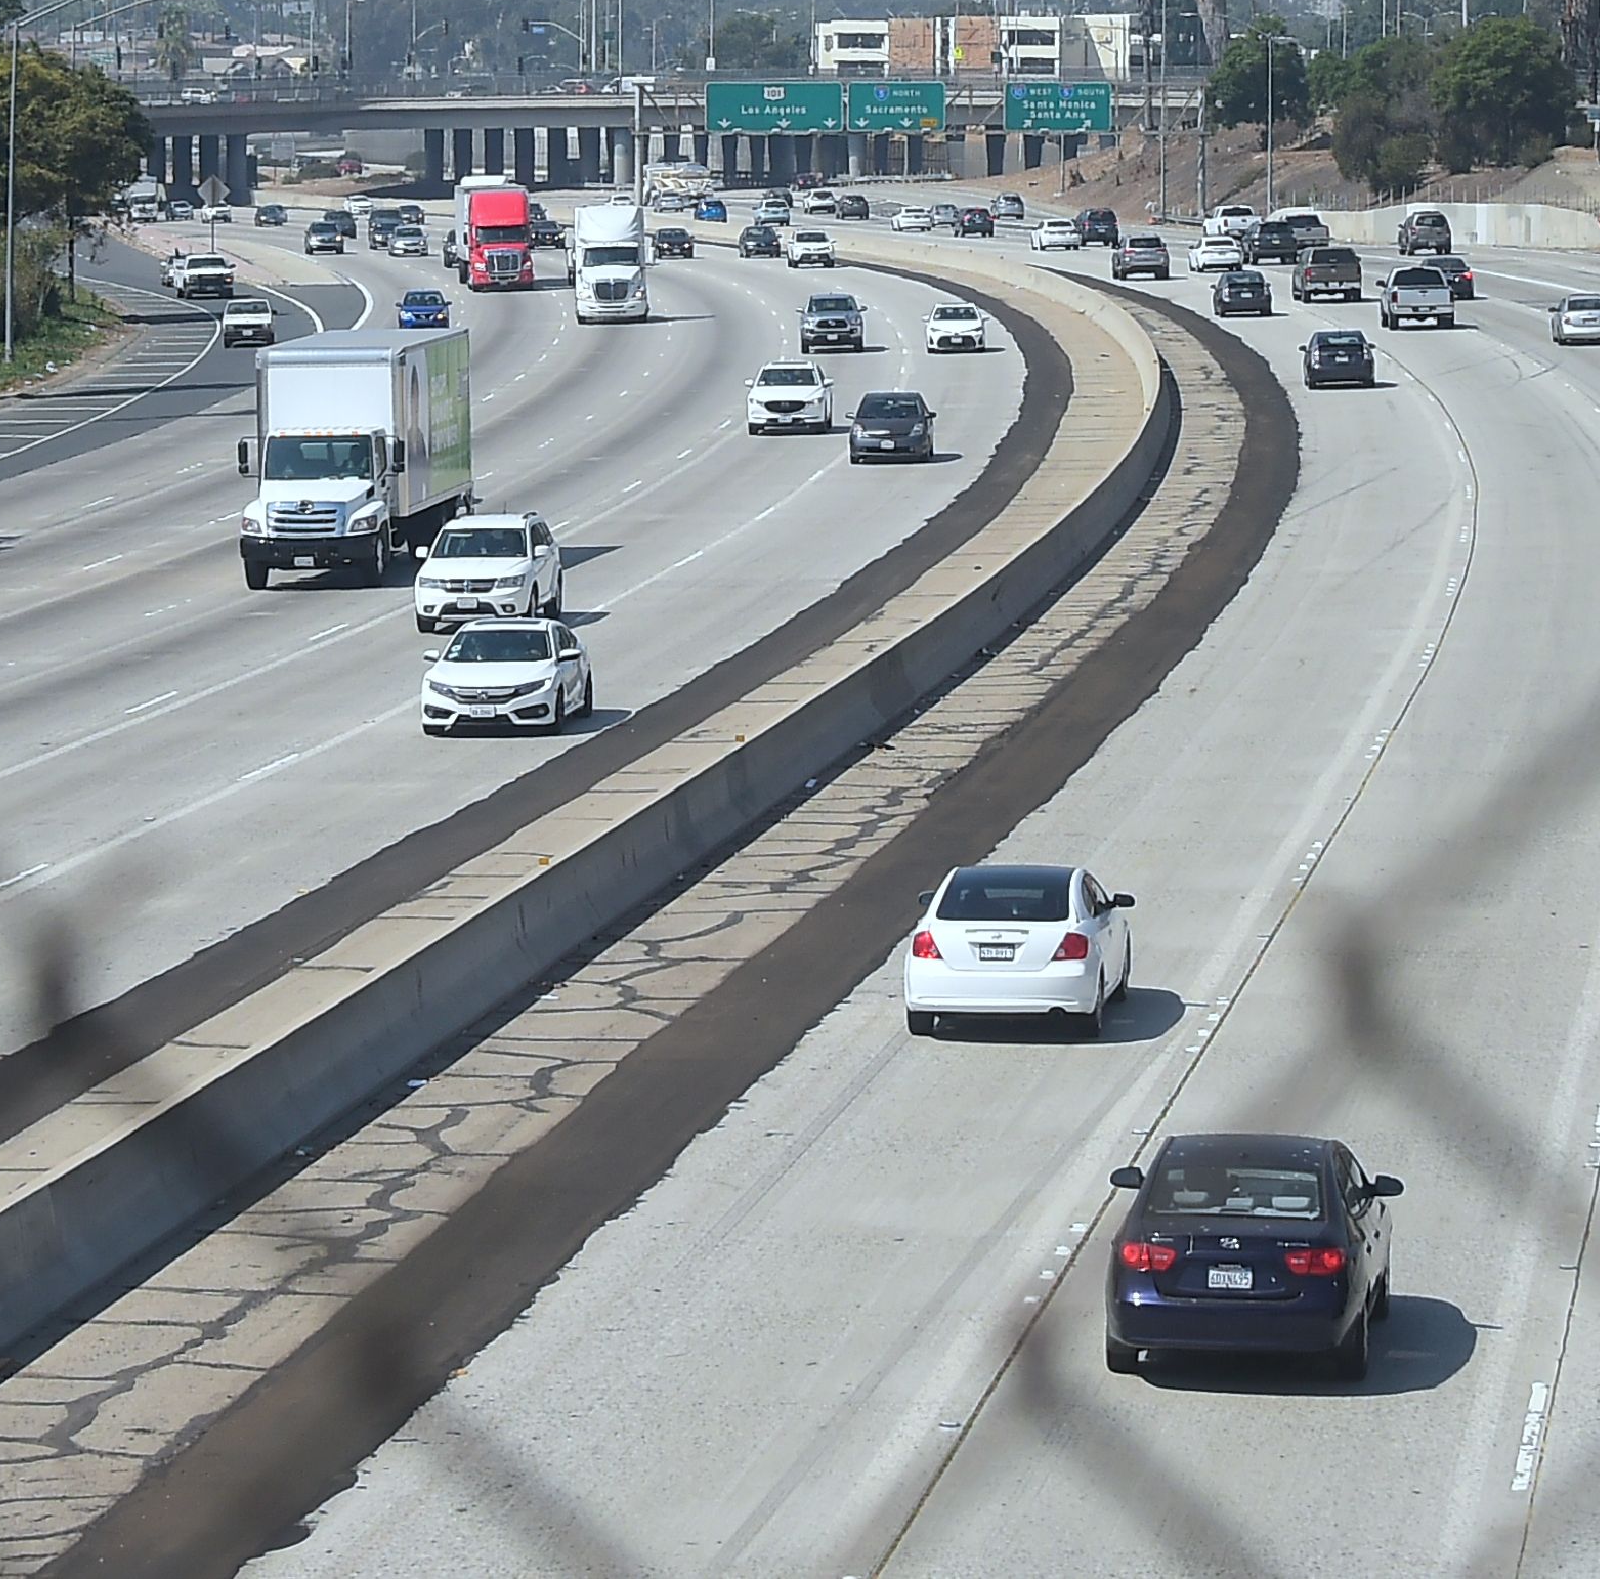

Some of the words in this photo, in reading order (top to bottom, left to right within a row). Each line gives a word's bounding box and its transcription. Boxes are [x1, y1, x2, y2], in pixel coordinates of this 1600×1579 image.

[892, 89, 921, 97] NORTH
[1029, 88, 1052, 96] WEST
[1077, 88, 1105, 96] SOUTH
[866, 104, 928, 114] Sacramento
[1022, 100, 1055, 110] Santa
[1059, 100, 1096, 110] Monica
[741, 105, 760, 114] Los
[764, 105, 807, 116] Angeles
[1029, 110, 1061, 119] Santa
[1064, 110, 1086, 119] Ana
